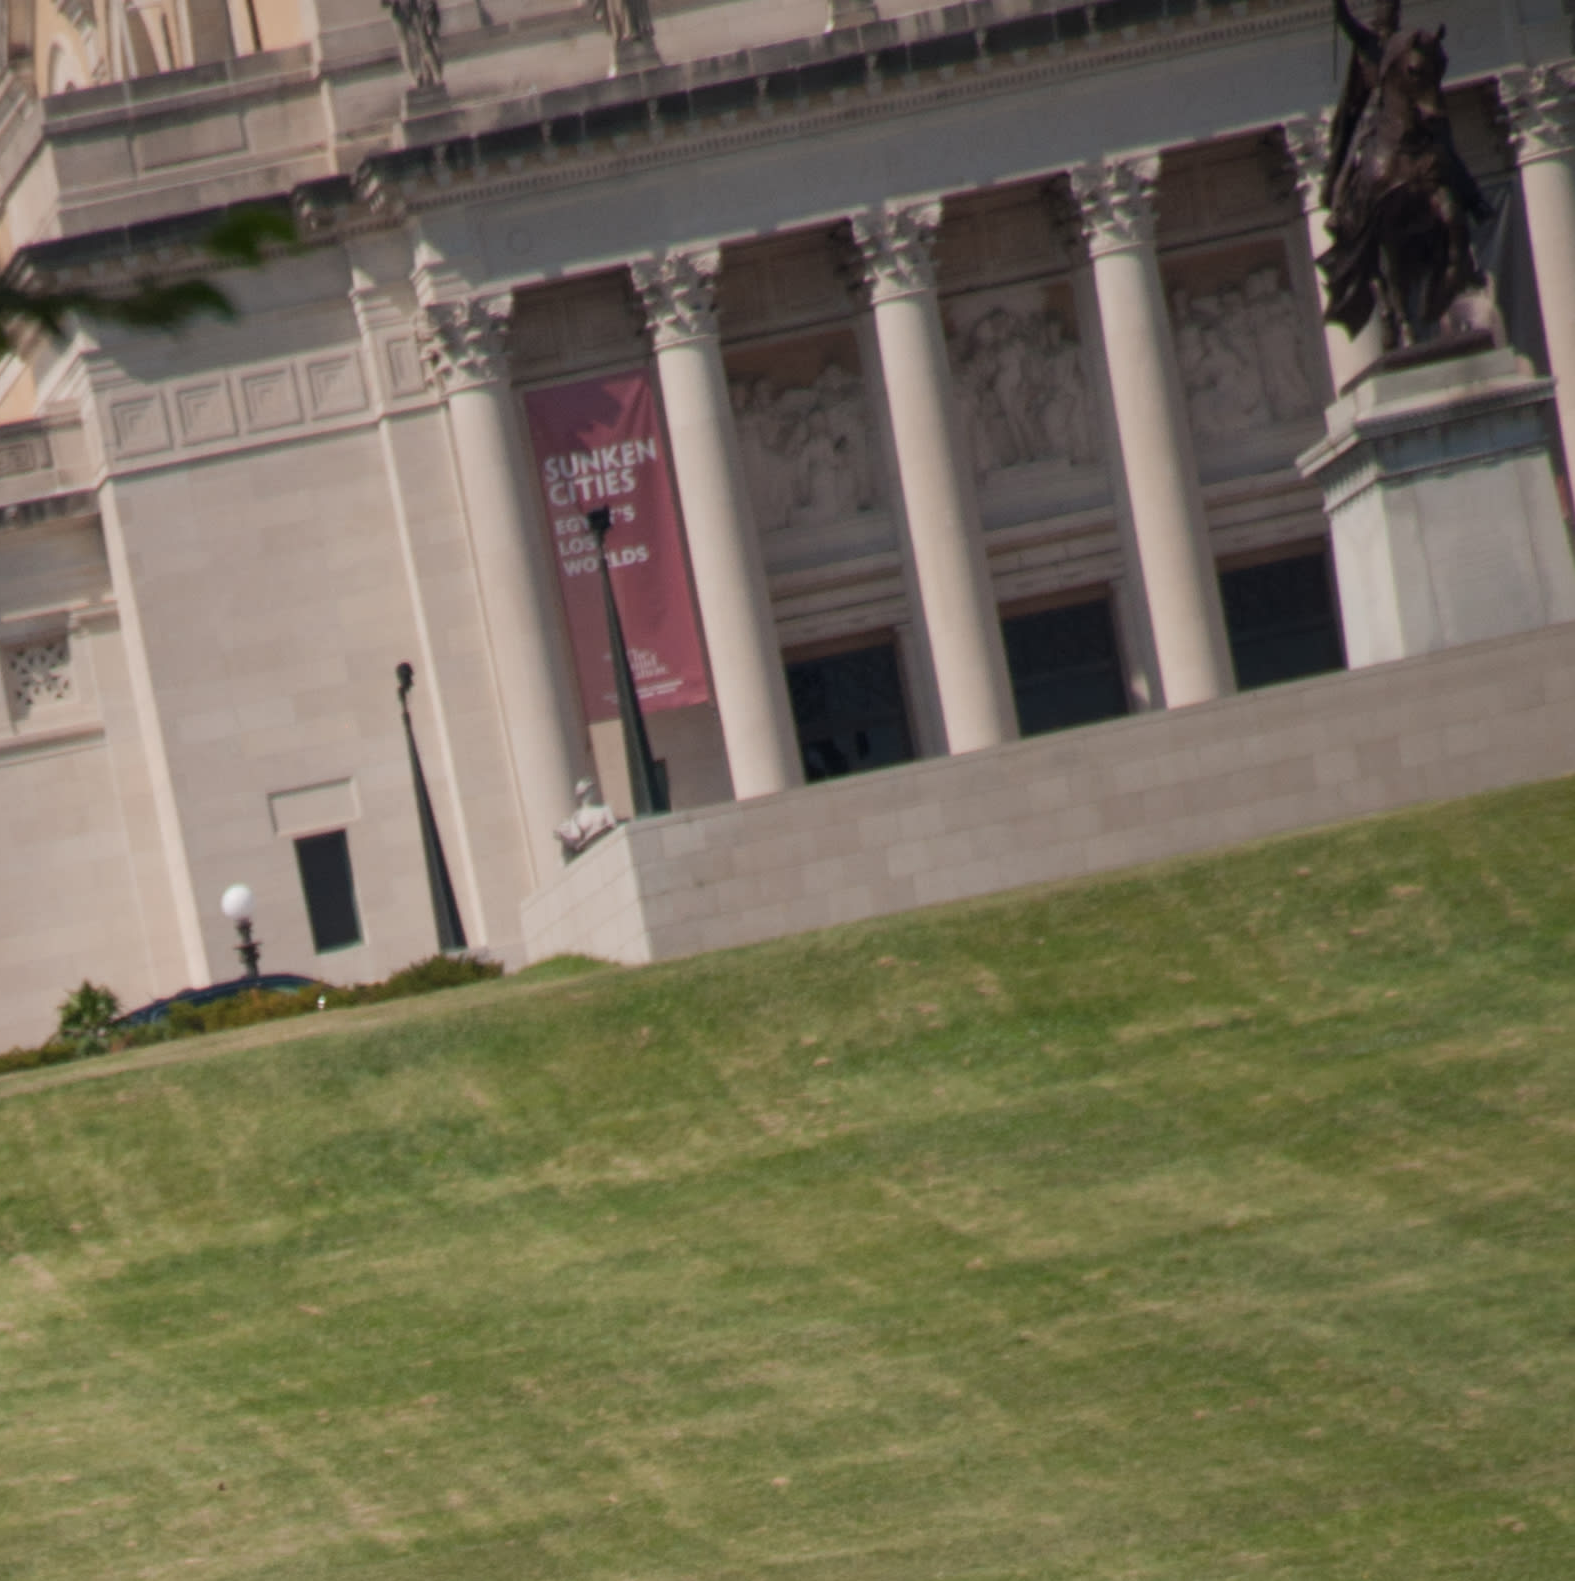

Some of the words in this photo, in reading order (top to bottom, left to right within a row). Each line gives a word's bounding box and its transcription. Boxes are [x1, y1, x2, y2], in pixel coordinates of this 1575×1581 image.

[544, 437, 657, 482] SUNKEN
[549, 467, 636, 506] CITIES
[554, 503, 636, 536] EGYT'S
[558, 533, 602, 557] LOS
